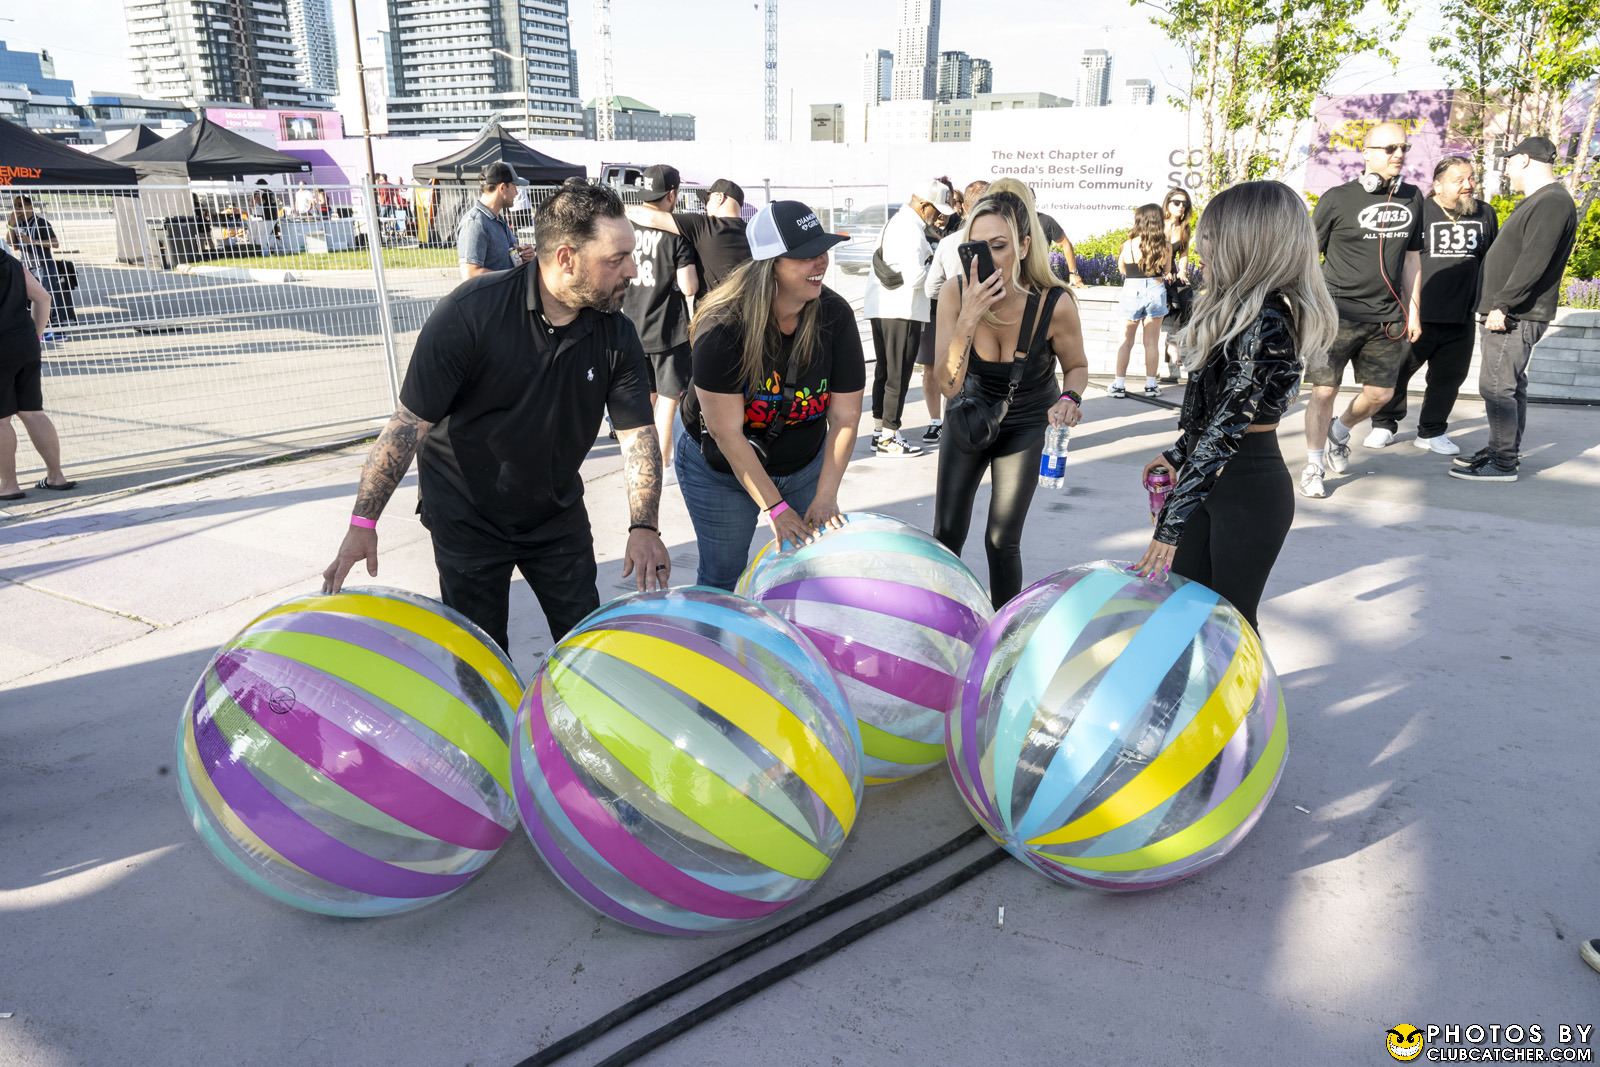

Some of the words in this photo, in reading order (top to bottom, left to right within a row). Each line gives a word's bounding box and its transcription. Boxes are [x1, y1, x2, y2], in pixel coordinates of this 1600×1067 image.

[992, 150, 1013, 160] The
[1017, 150, 1045, 160] Next
[1048, 149, 1099, 162] Chapter
[1102, 149, 1116, 160] of
[991, 165, 1045, 175] Canada's
[1048, 164, 1124, 177] Best-Selling
[1024, 179, 1074, 189] minium
[1078, 179, 1153, 192] Community
[1438, 225, 1478, 250] 333
